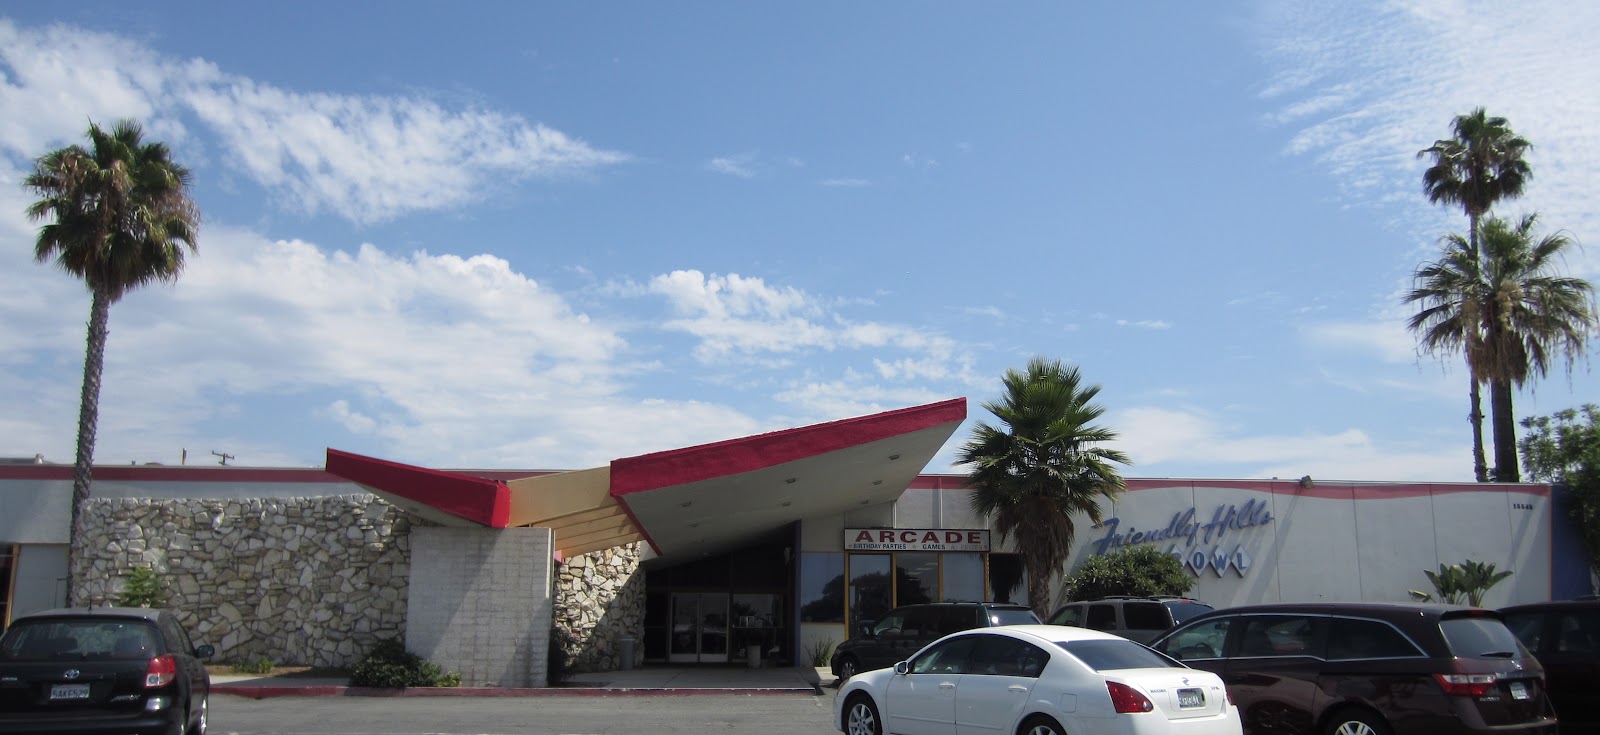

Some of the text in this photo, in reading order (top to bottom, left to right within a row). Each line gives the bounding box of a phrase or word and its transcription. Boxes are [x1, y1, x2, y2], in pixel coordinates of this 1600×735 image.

[854, 530, 982, 544] ARCADE
[1091, 498, 1275, 556] Friendly Hills
